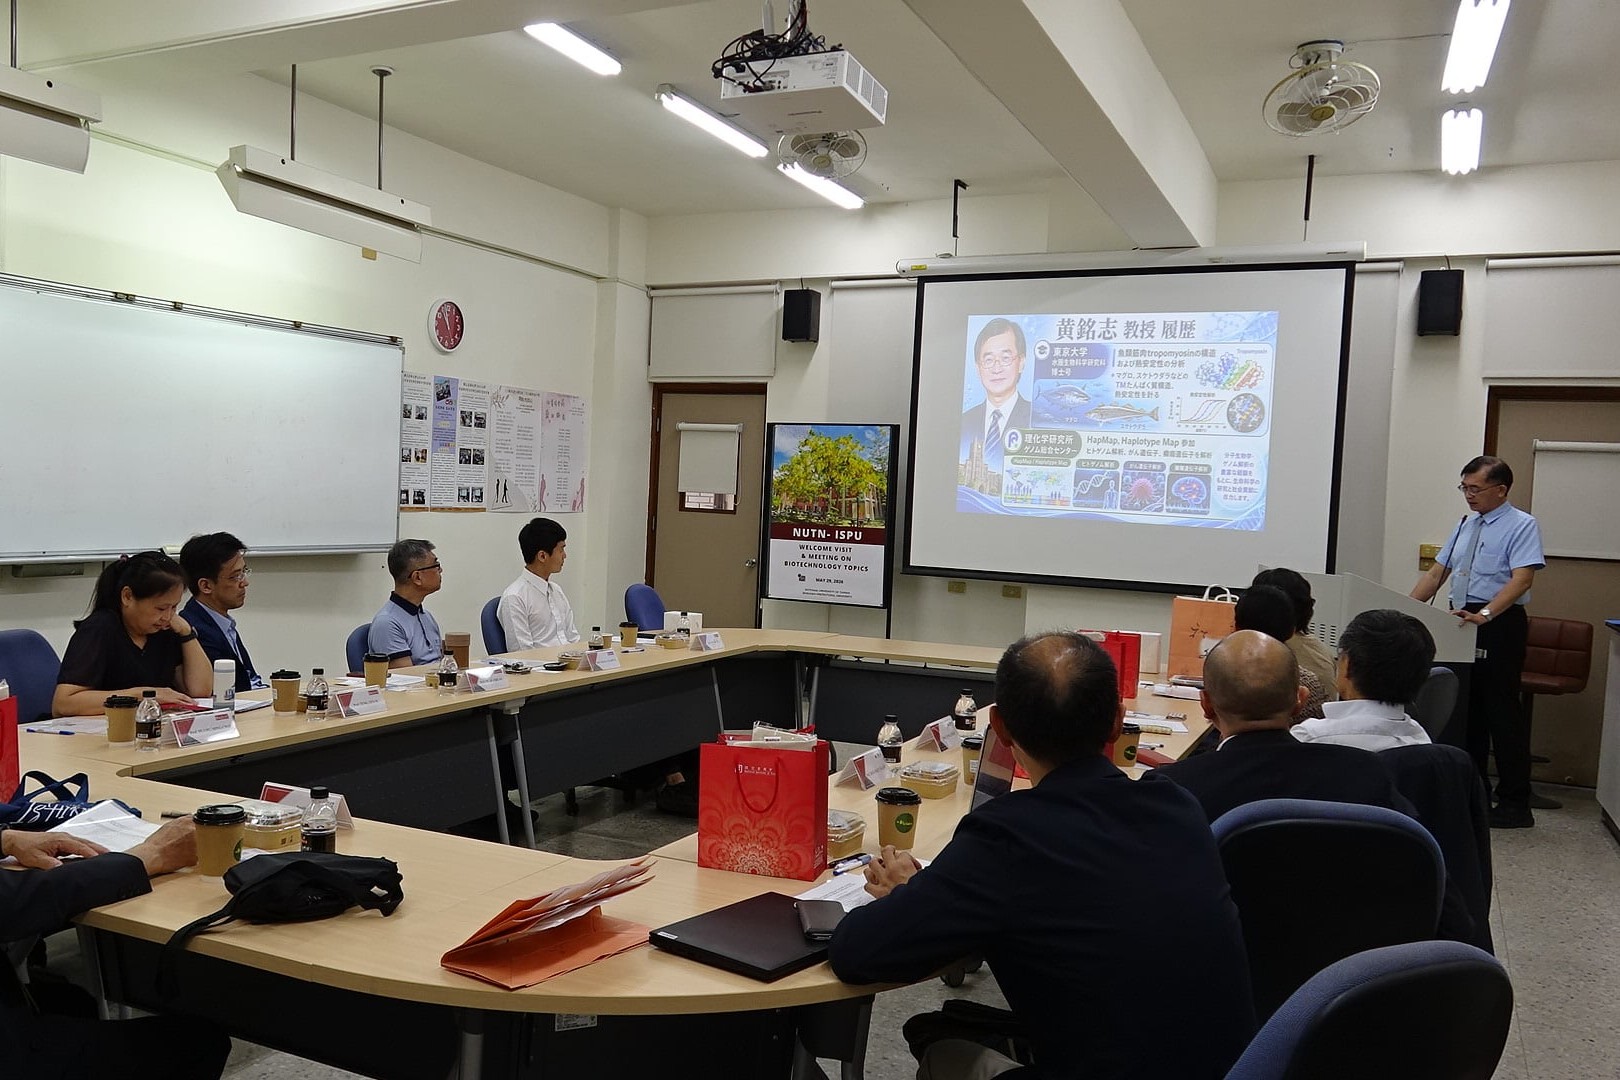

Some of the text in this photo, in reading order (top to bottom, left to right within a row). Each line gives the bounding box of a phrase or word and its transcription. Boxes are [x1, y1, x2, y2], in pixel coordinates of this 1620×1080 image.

[1123, 319, 1155, 339] 教授
[1053, 347, 1088, 357] 東京大学
[1024, 433, 1074, 445] 理化学研究所
[1121, 436, 1160, 447] Haplotype
[1162, 438, 1180, 448] Map
[792, 527, 863, 540] NUTN- ISPU
[799, 544, 832, 552] WELCOME
[808, 553, 839, 561] MEETING
[784, 560, 869, 572] BIOTECHNOLOGY TOPICS
